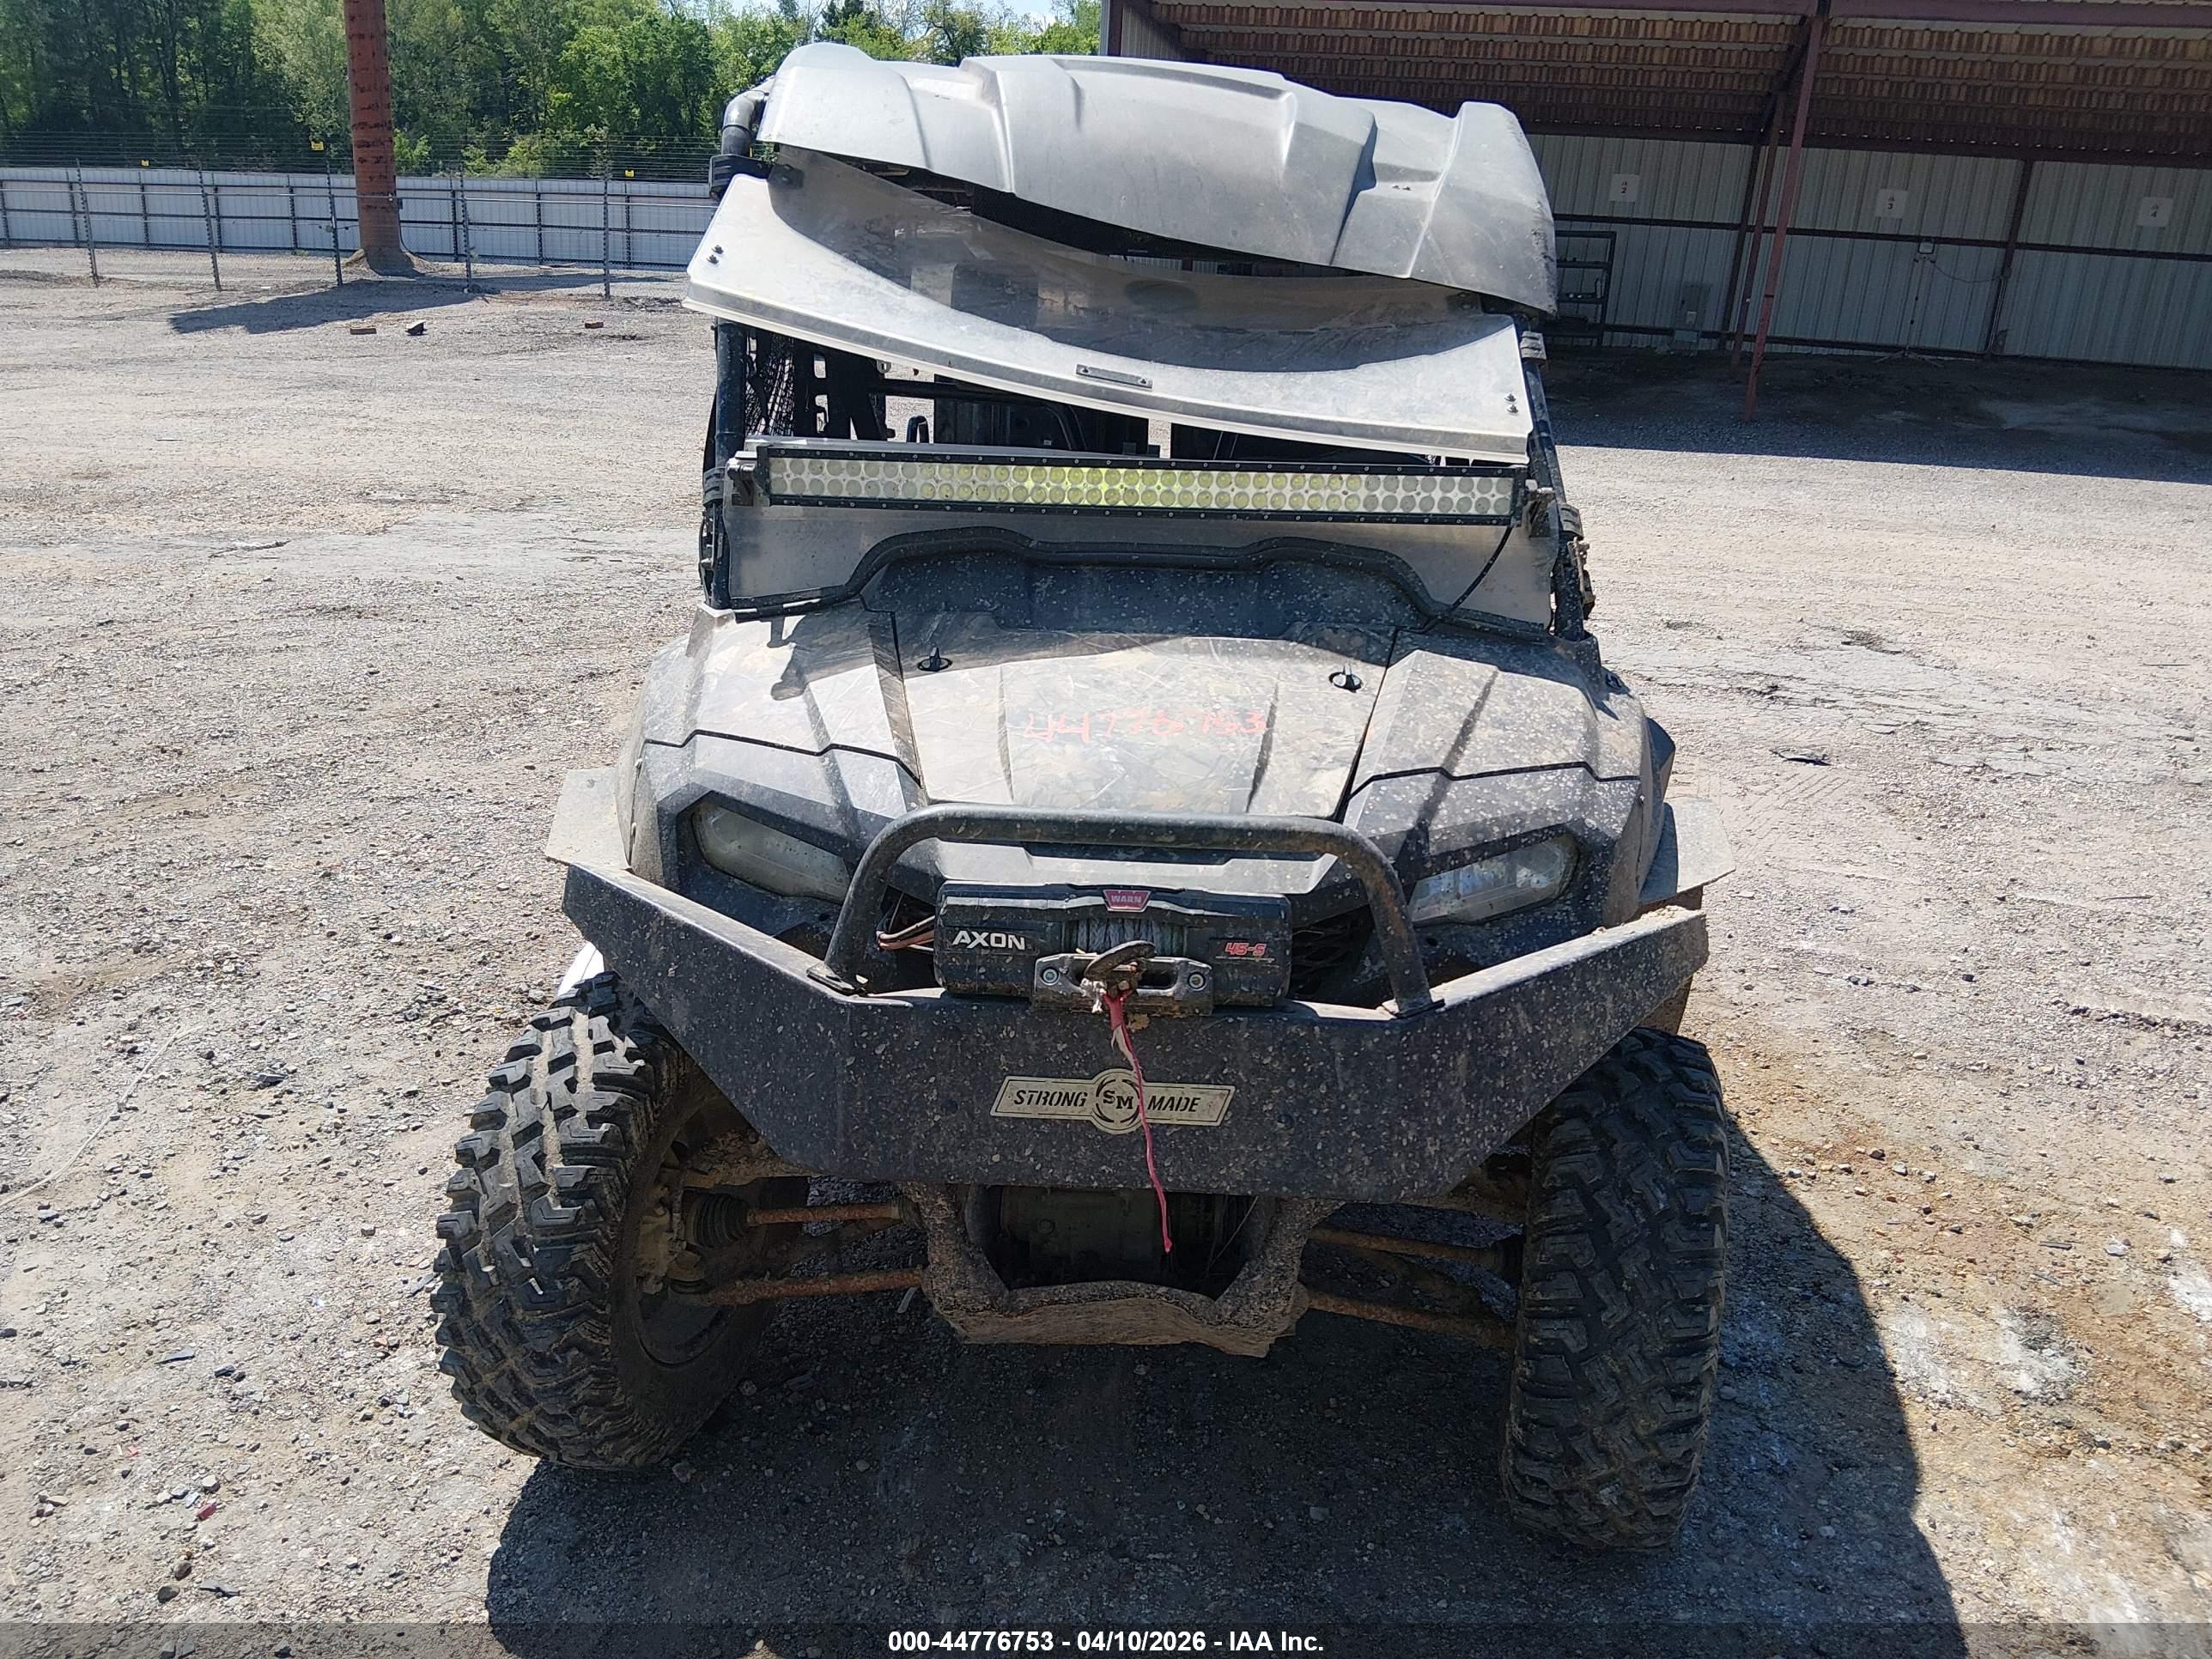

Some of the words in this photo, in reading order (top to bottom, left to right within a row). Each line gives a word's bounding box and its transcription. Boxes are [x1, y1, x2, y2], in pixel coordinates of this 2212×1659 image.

[1110, 895, 1142, 903] WARN
[951, 930, 1025, 951] AXON
[1224, 942, 1267, 956] 45-S
[1013, 1090, 1088, 1108] STRONG
[1103, 1090, 1133, 1110] SM
[1147, 1095, 1201, 1113] MADE
